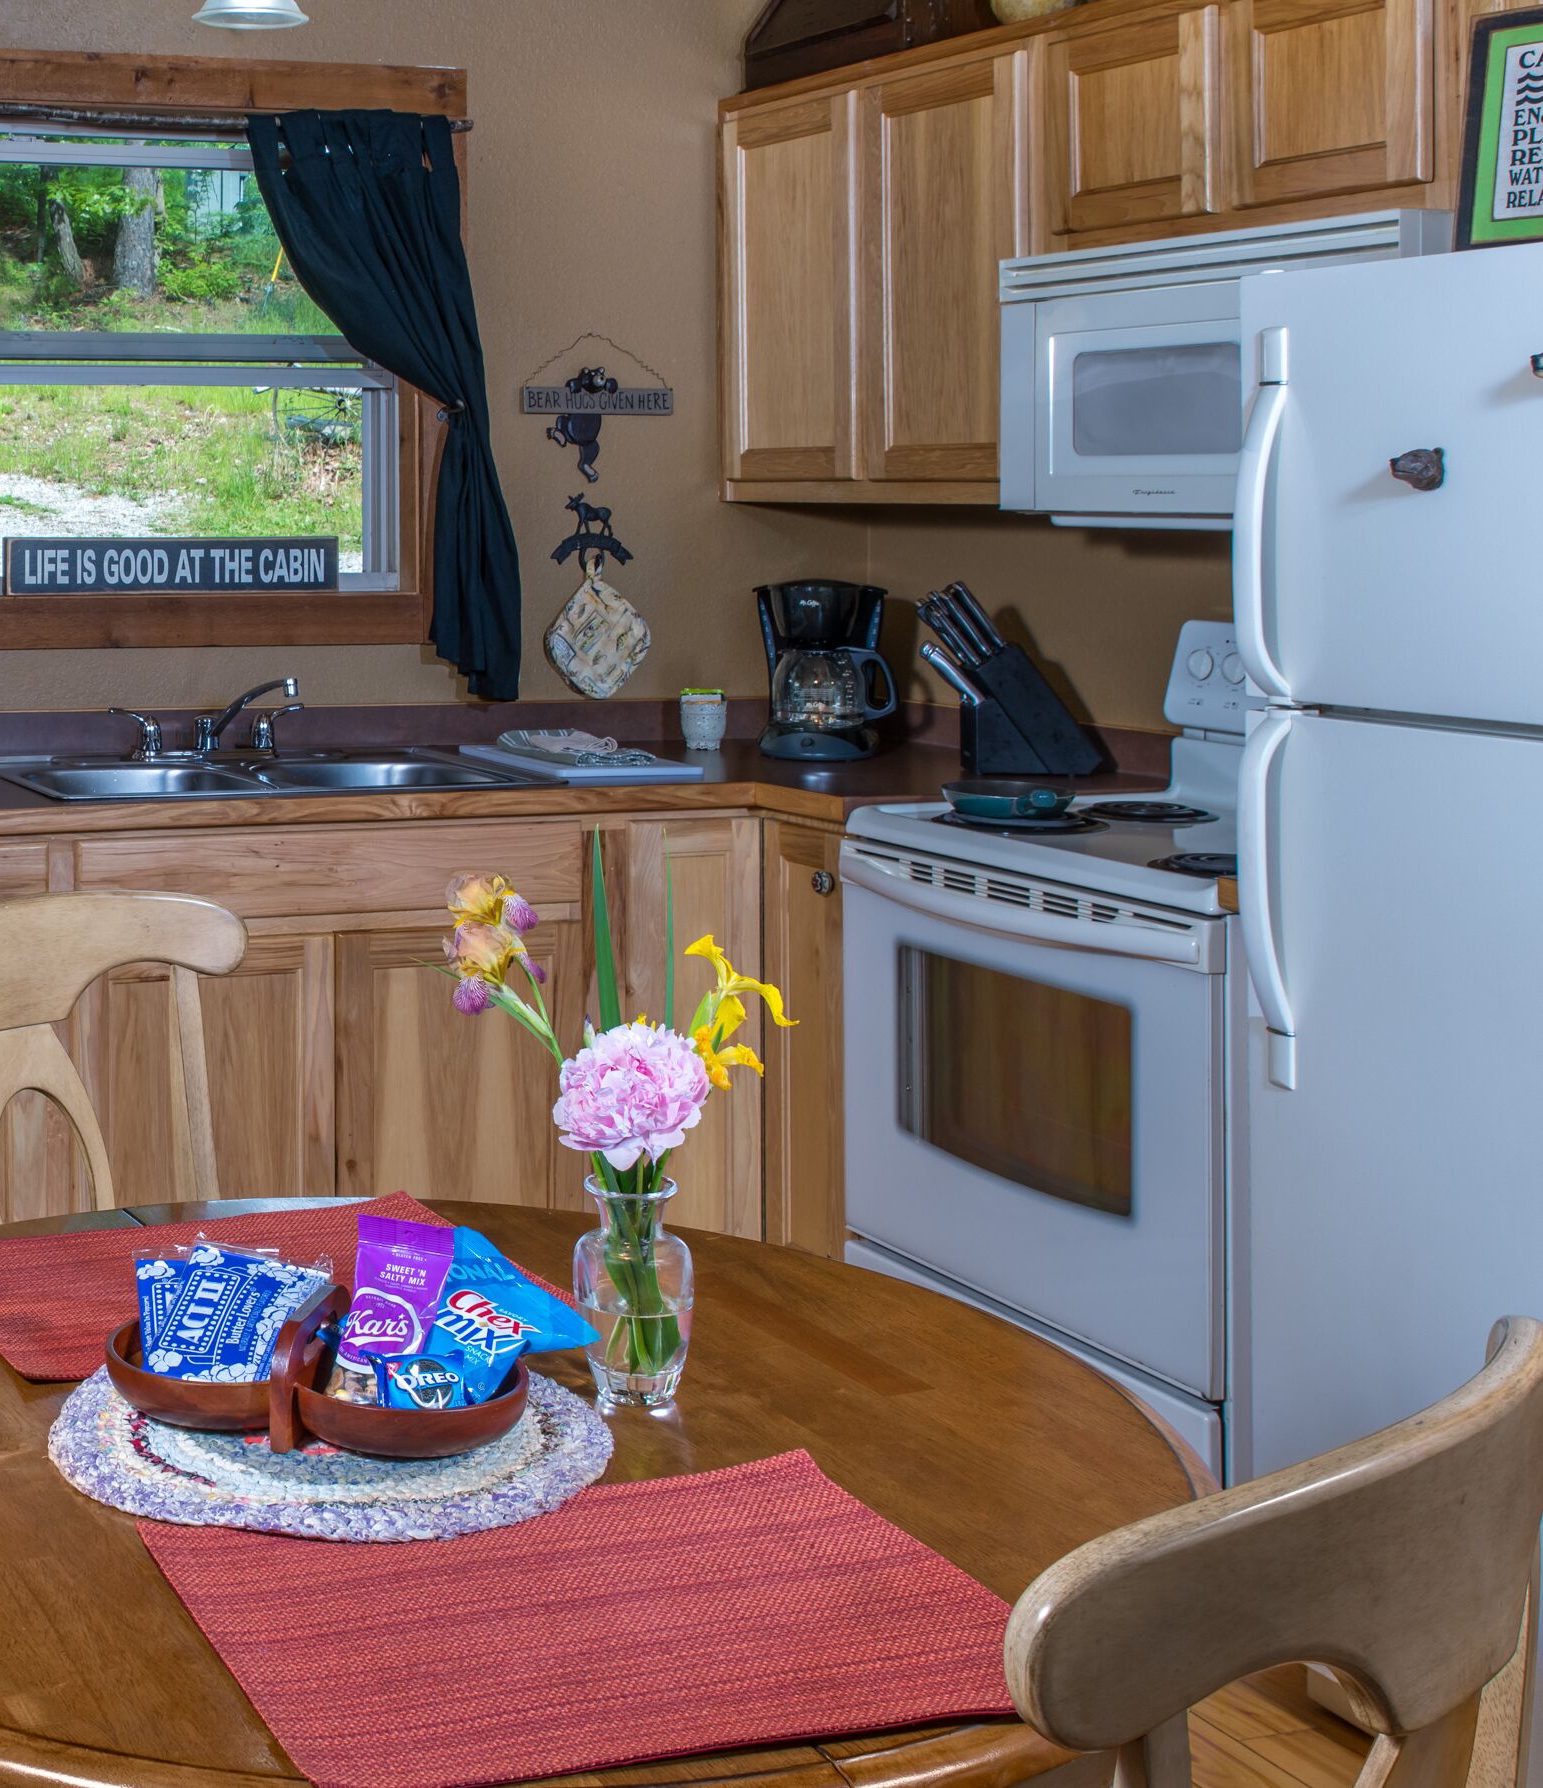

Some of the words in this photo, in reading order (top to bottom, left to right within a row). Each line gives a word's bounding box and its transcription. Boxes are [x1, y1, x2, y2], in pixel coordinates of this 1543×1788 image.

[1513, 107, 1543, 126] EN
[1511, 127, 1543, 146] PL
[527, 390, 561, 408] BEAR
[565, 392, 595, 410] HUGS
[599, 392, 634, 410] GIVEN
[638, 393, 671, 410] HERE
[24, 549, 69, 584] LIFE
[76, 549, 97, 584] IS
[103, 549, 169, 584] GOOD
[174, 549, 205, 583] AT
[210, 549, 253, 583] THE
[259, 548, 325, 583] CABIN
[379, 1271, 406, 1283] SALTY
[408, 1276, 426, 1286] MIX
[385, 1263, 416, 1276] SWEET
[194, 1279, 226, 1302] II
[225, 1321, 246, 1344] Butter
[238, 1292, 260, 1318] Lovers
[447, 1290, 539, 1336] Chex
[177, 1303, 214, 1344] ACT
[397, 1372, 459, 1390] OREO
